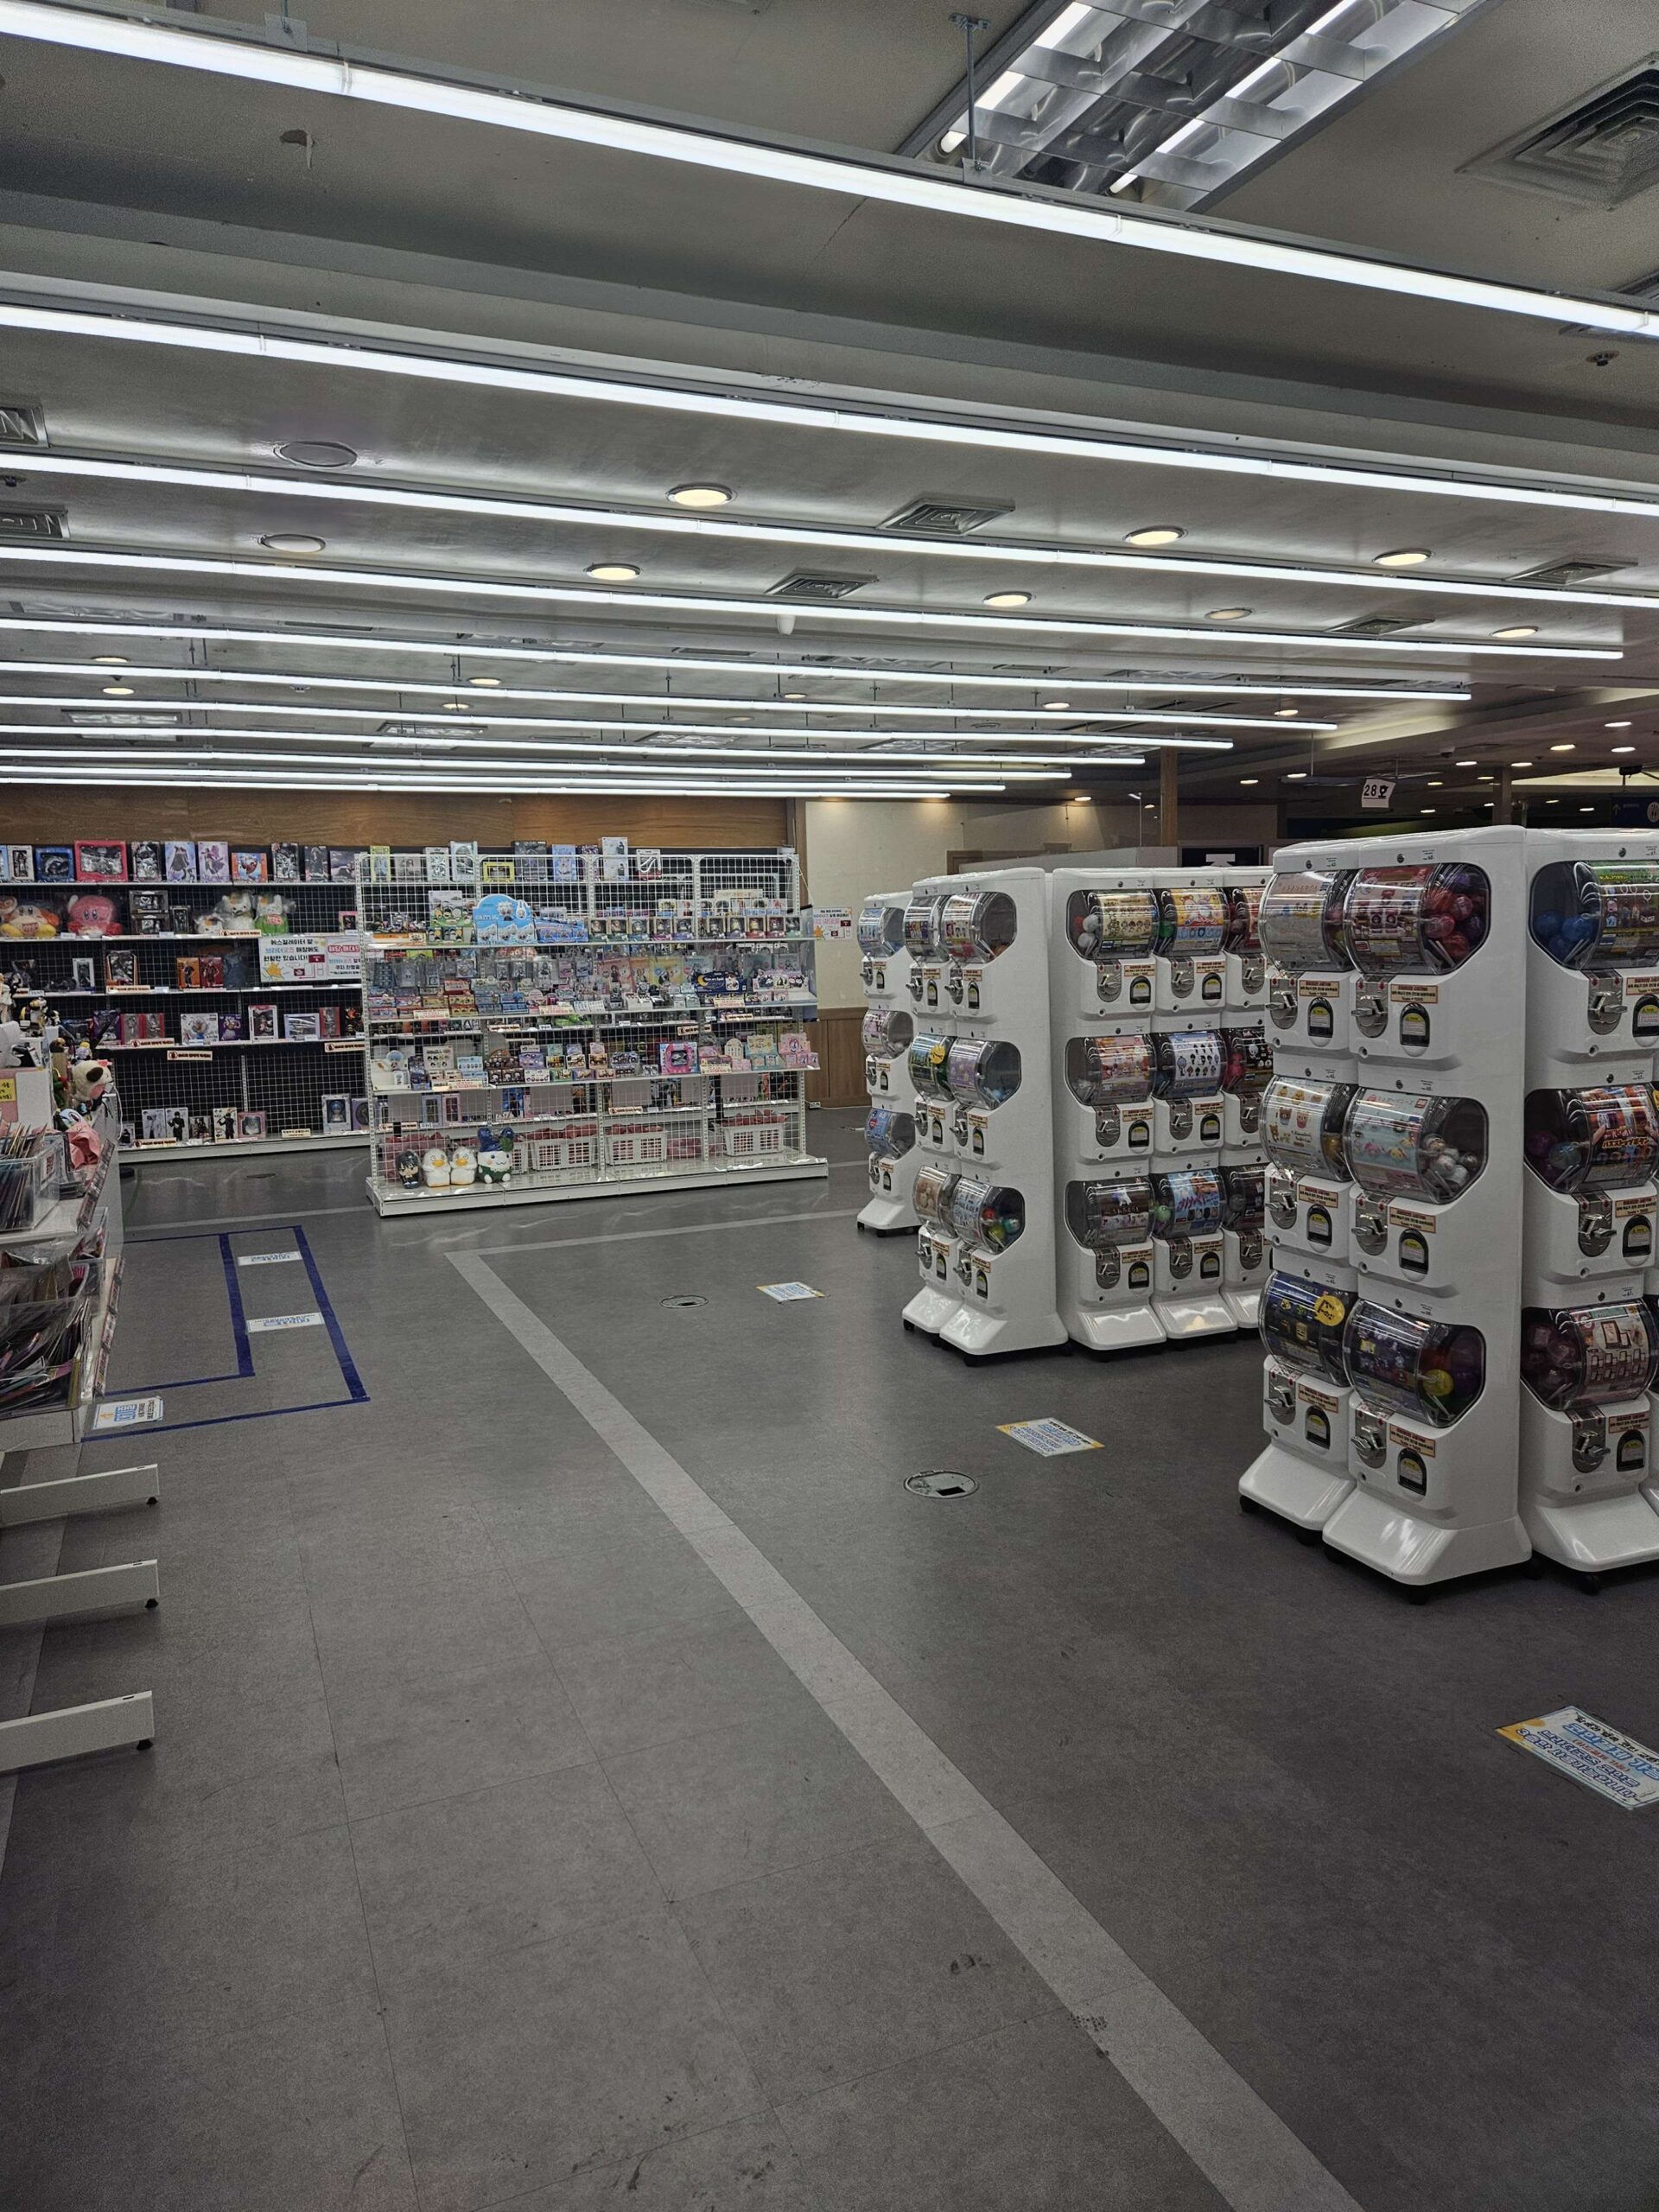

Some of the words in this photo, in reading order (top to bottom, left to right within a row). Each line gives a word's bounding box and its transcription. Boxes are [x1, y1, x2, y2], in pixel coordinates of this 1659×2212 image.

[1537, 1729, 1602, 1766] 브라더굿즈
[1597, 1764, 1640, 1788] 코인은
[1560, 1722, 1633, 1760] 코인결제
[1548, 1749, 1637, 1798] 사용가능합니다
